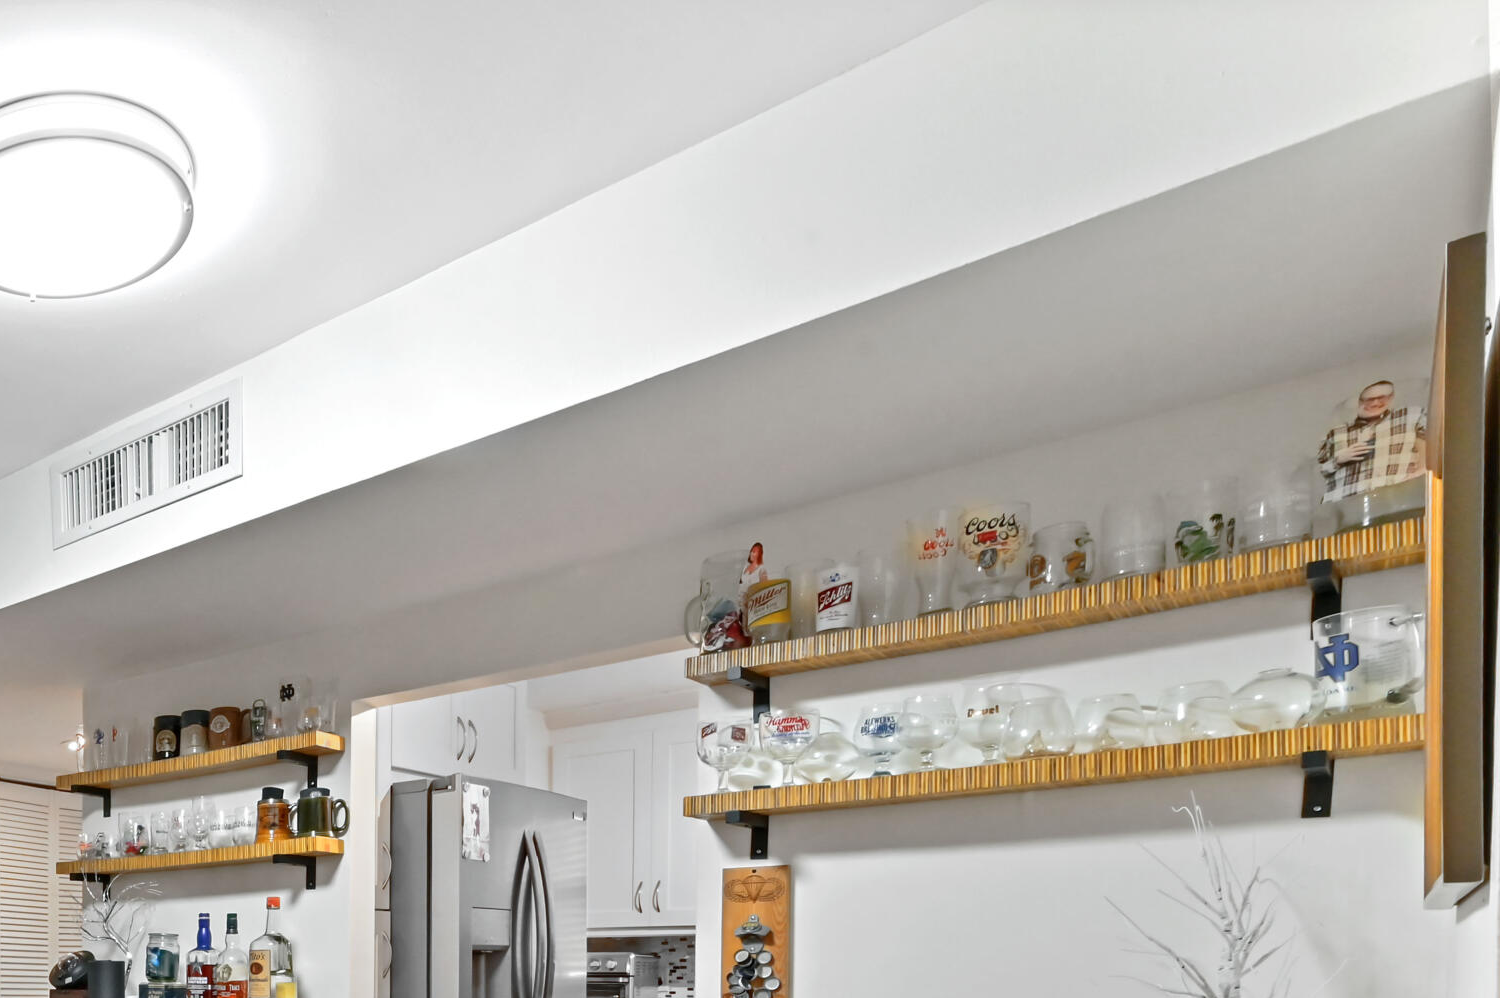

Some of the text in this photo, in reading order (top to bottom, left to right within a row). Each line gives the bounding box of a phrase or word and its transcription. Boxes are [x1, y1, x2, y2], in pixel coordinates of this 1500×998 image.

[965, 512, 1020, 536] Coors
[748, 586, 783, 612] Miller
[819, 584, 852, 611] Schlitz
